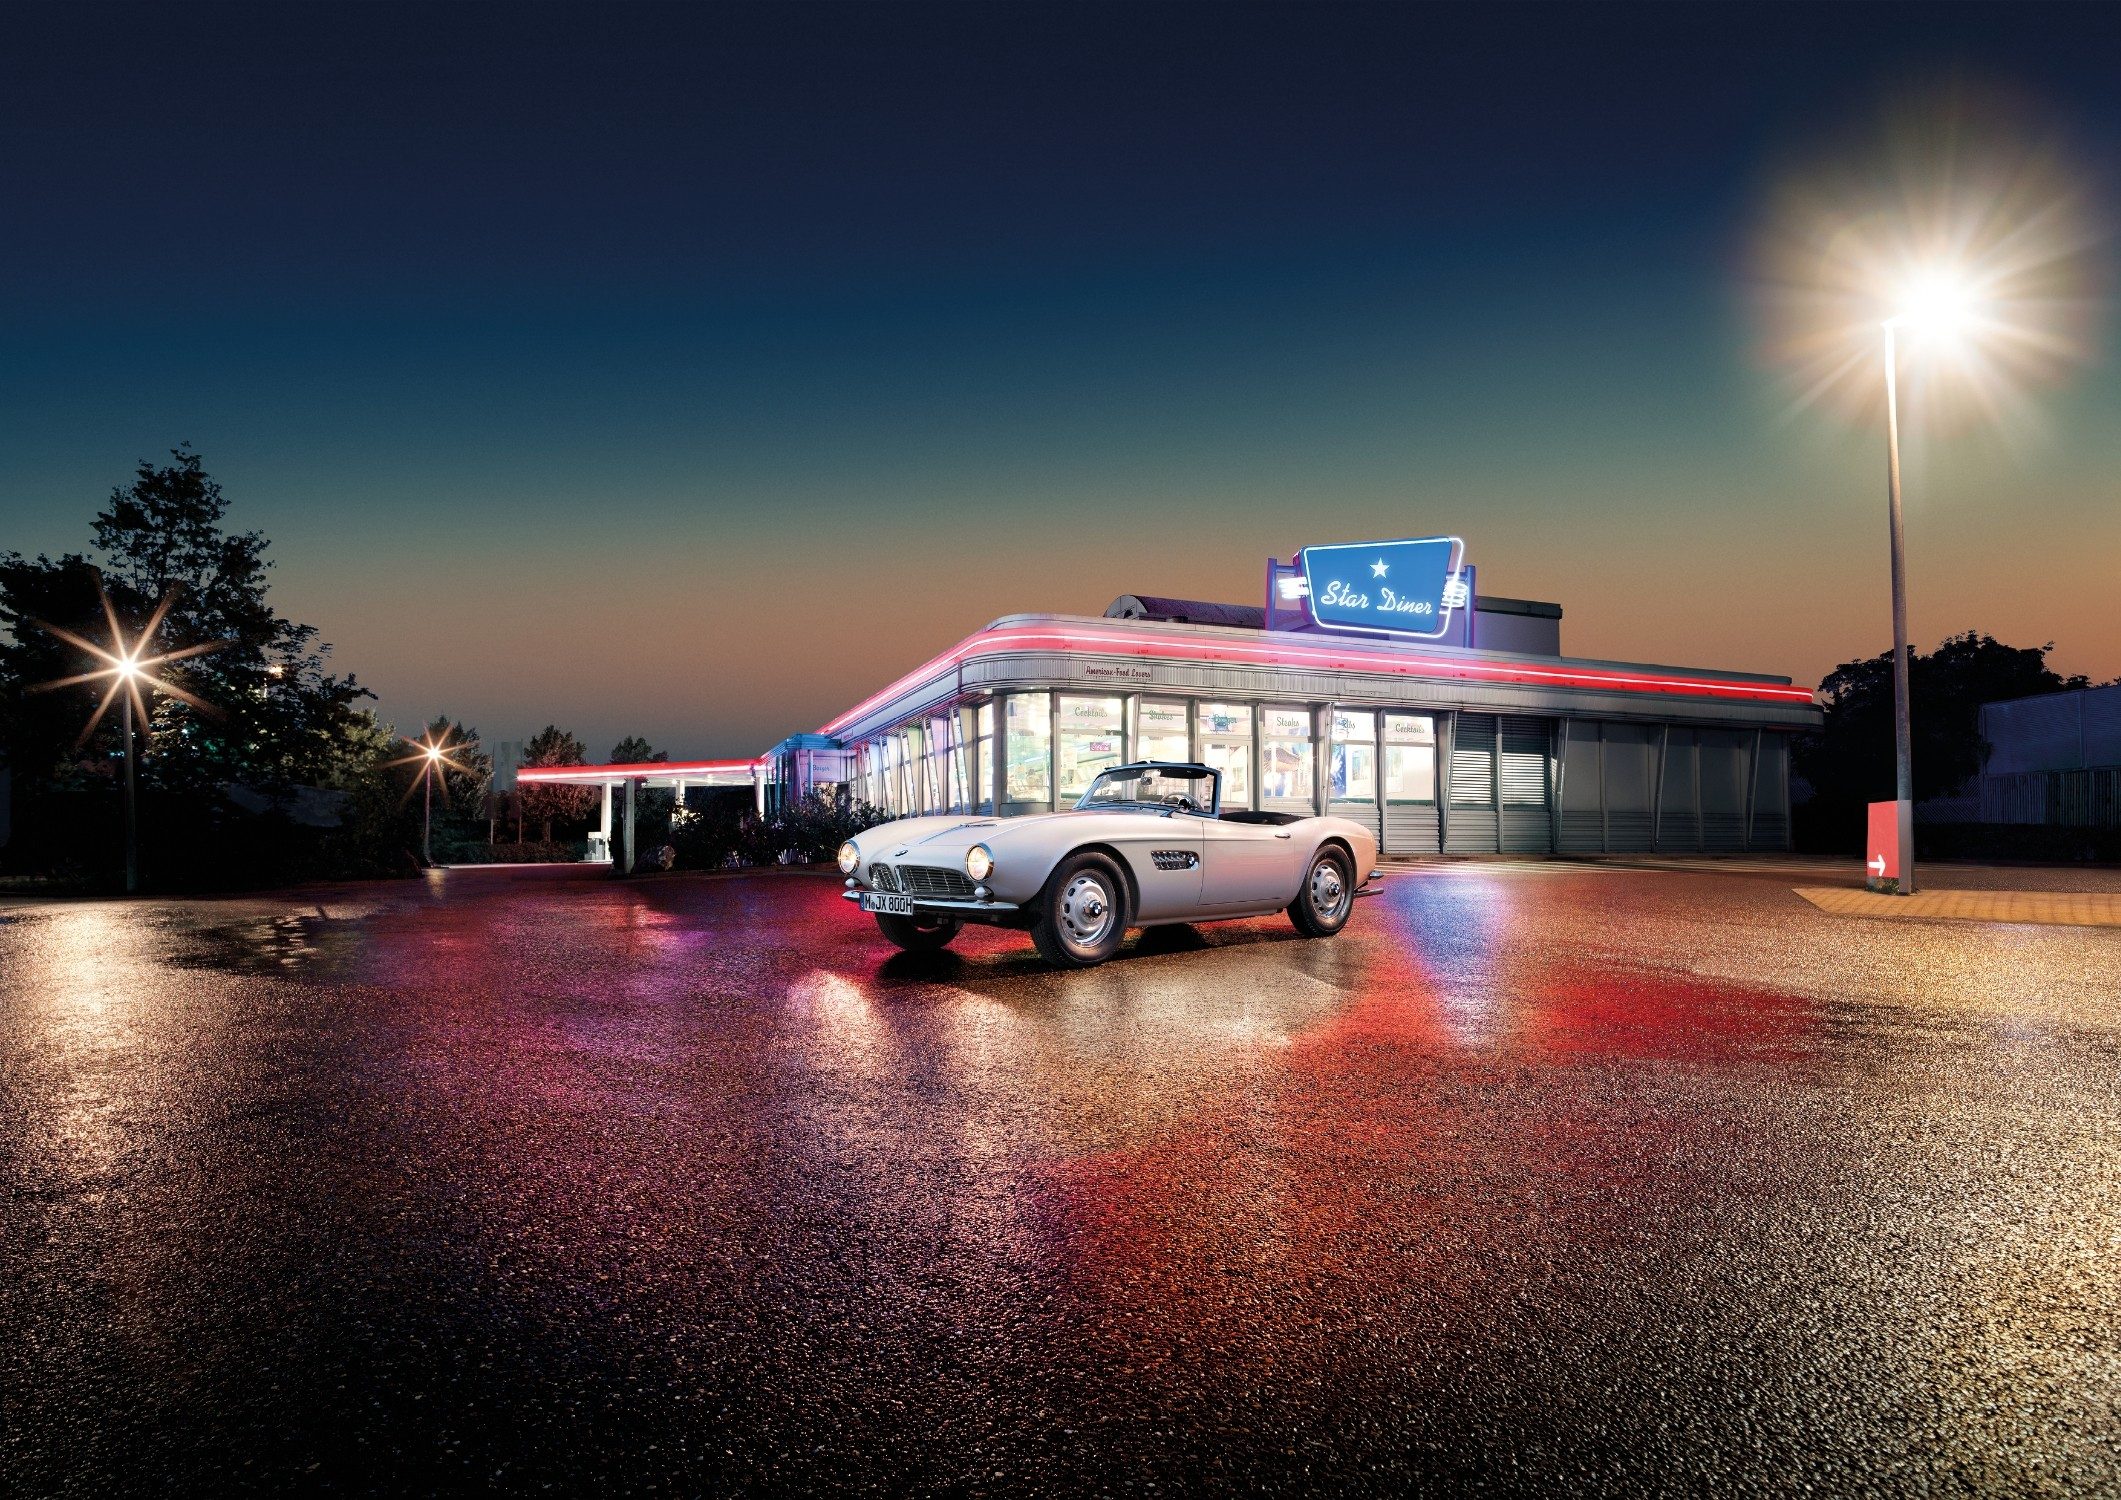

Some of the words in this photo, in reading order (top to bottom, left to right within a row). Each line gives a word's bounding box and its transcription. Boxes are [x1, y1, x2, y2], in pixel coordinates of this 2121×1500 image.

[1320, 580, 1369, 609] Star
[1376, 587, 1433, 615] Diner
[1131, 668, 1151, 678] Lovers
[1074, 706, 1108, 718] Cocktails
[1276, 716, 1300, 727] Steaks
[1395, 722, 1425, 734] Cocktails
[876, 895, 887, 911] JX
[888, 896, 912, 914] 800H
